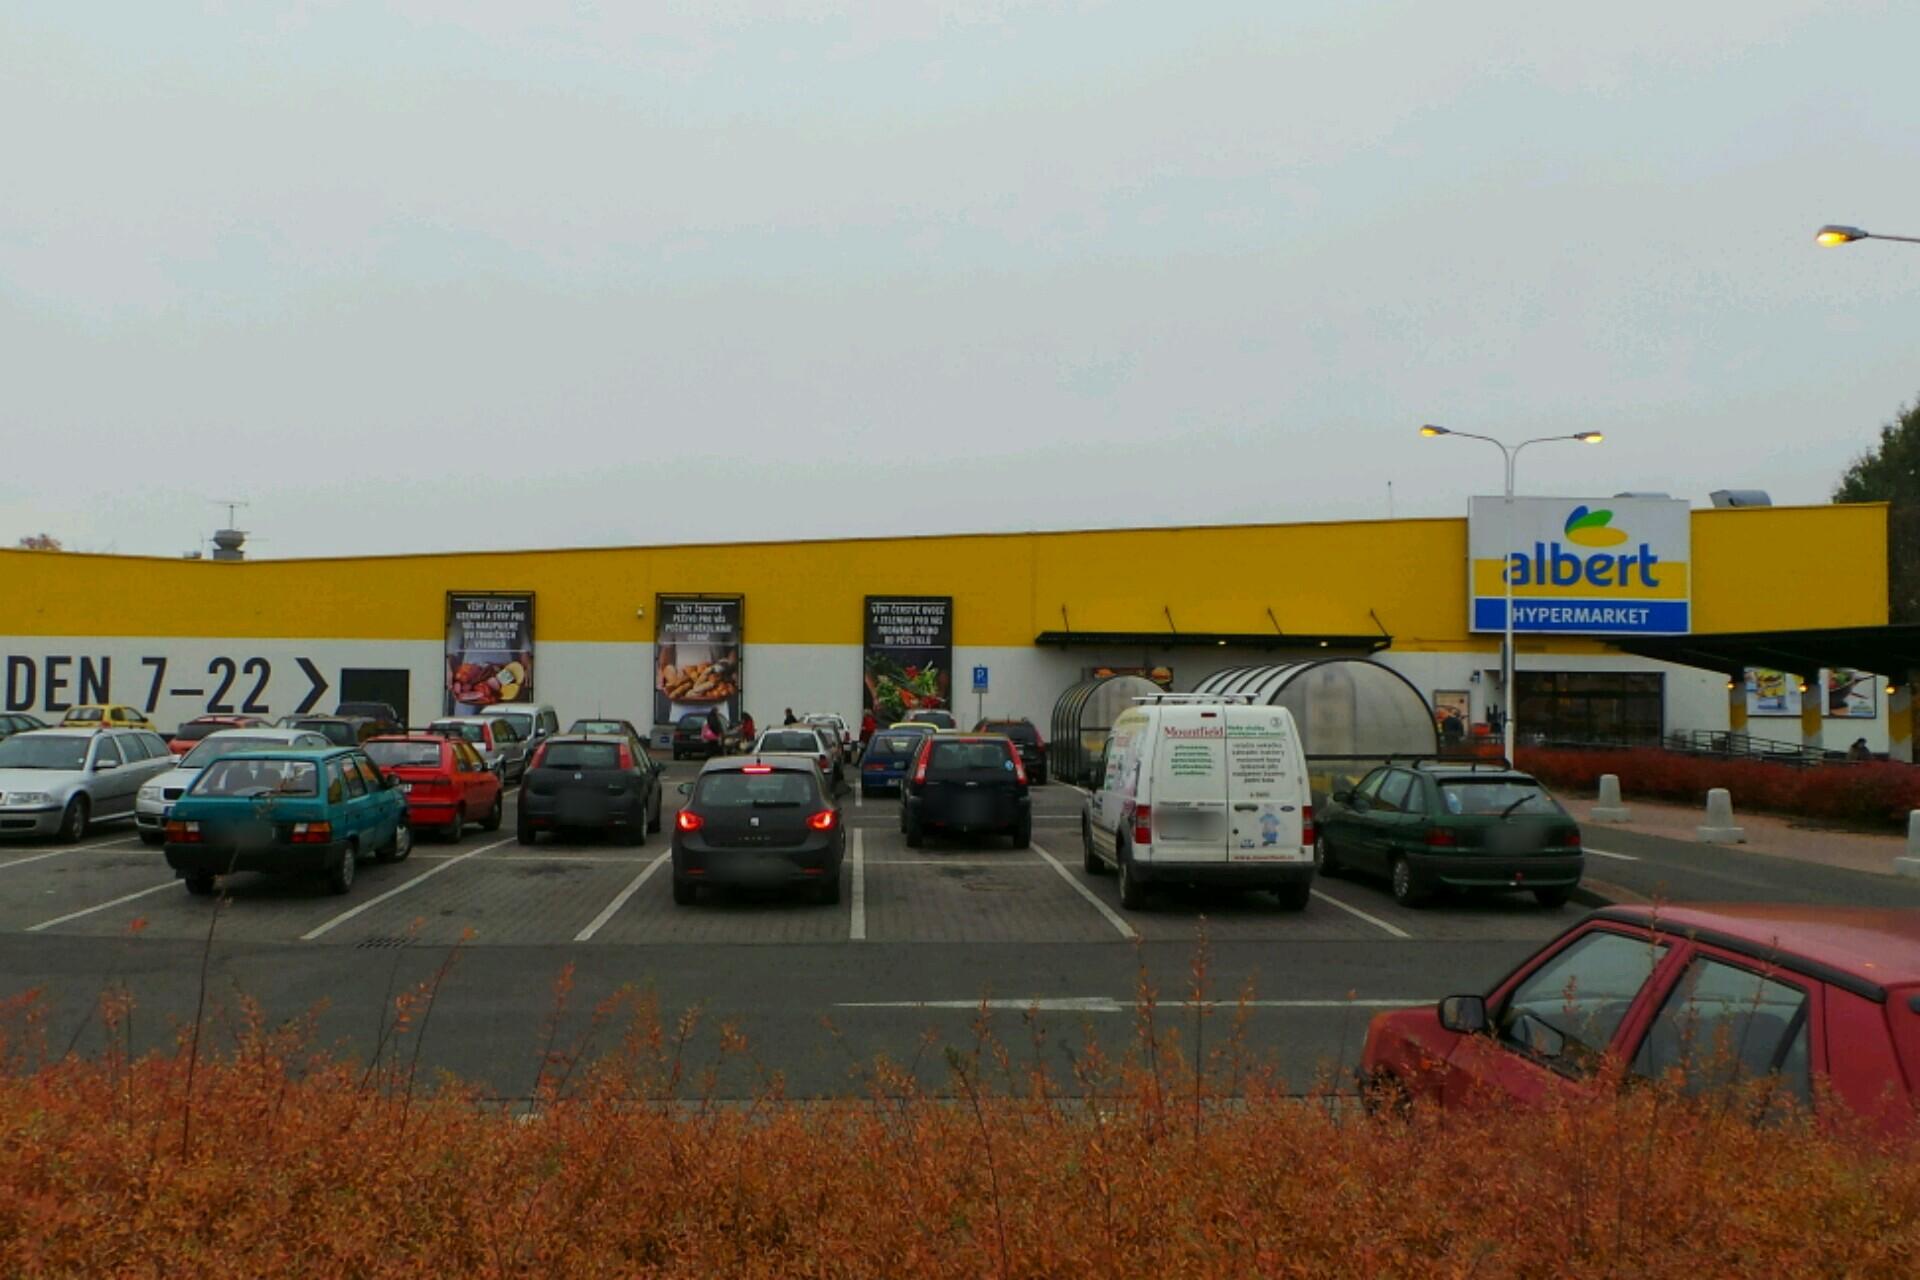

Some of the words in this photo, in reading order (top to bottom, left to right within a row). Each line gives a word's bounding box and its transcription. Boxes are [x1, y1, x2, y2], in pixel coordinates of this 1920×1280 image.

[1503, 541, 1660, 588] albert
[1512, 607, 1649, 625] HYPERMARKET
[6, 655, 111, 712] DEN
[1164, 726, 1223, 738] Mountfield
